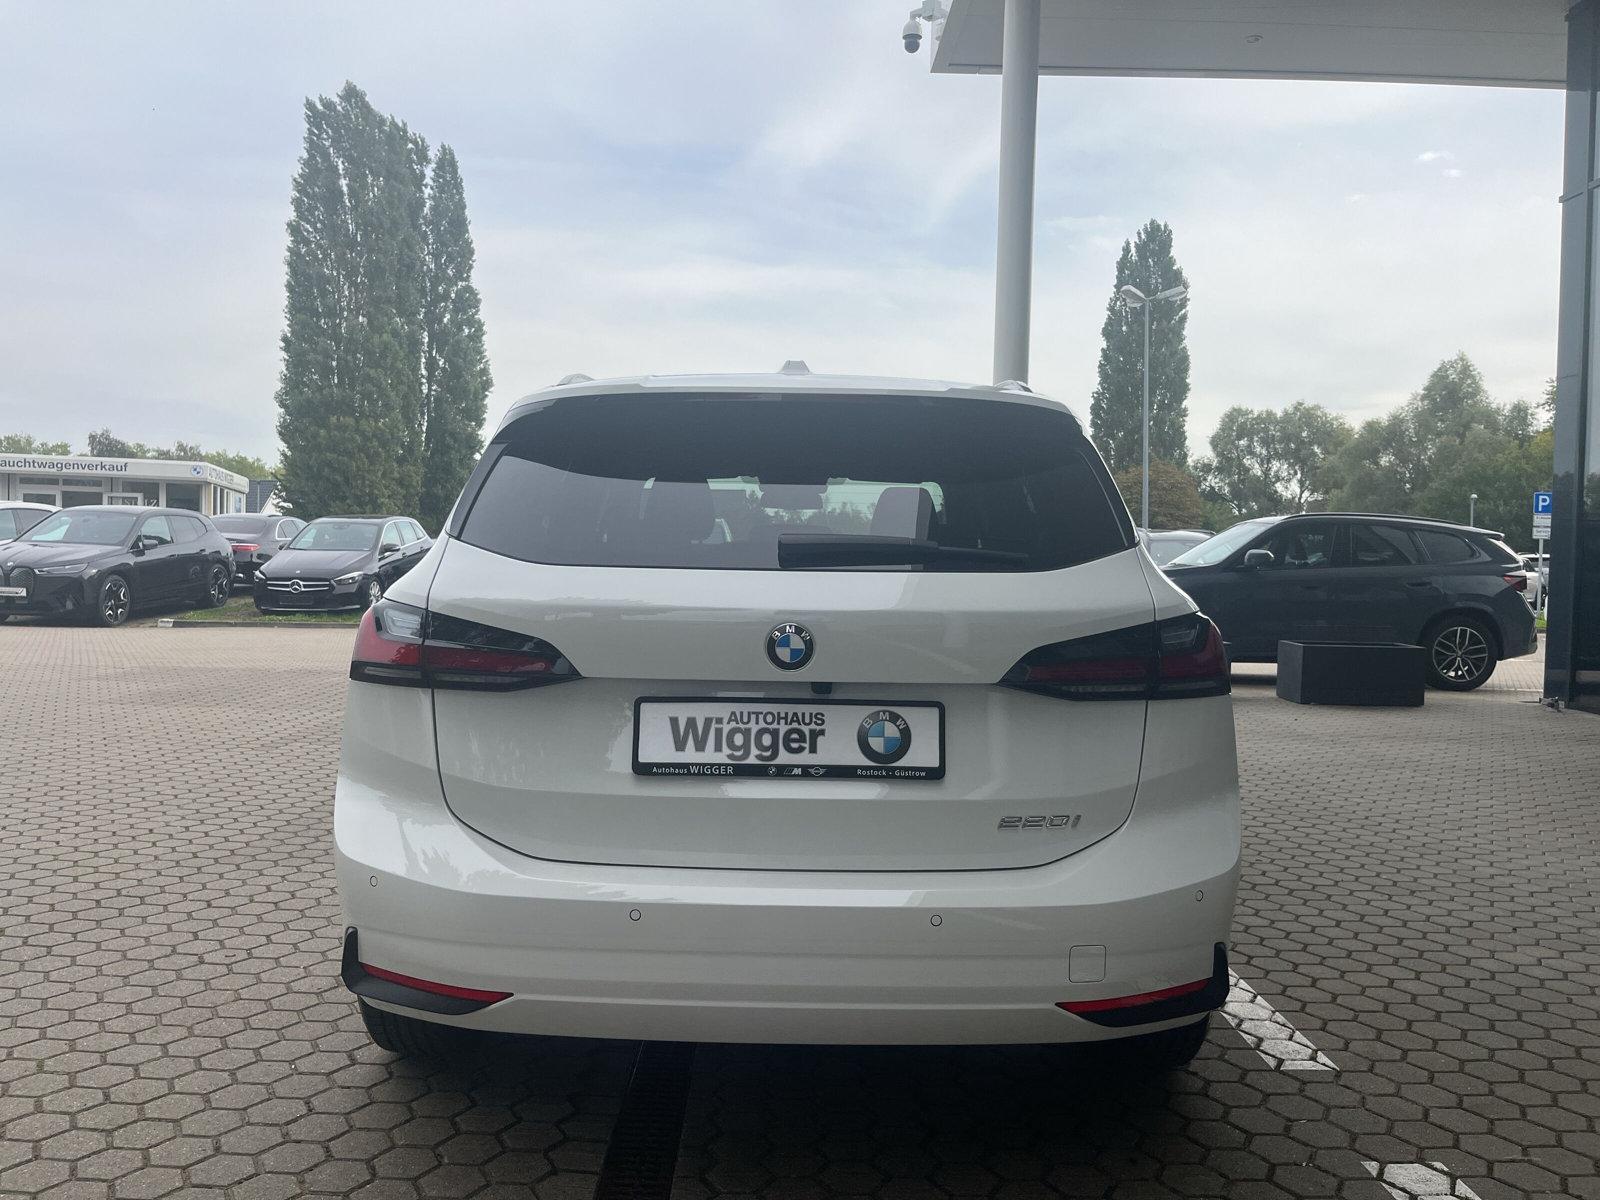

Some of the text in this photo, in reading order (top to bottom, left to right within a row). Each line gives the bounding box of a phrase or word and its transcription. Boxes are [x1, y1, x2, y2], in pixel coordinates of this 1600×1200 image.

[0, 458, 128, 472] auchtwagenverkauf
[1538, 495, 1550, 511] P
[772, 625, 810, 641] BMW
[726, 711, 825, 726] AUTOHAUS
[862, 711, 907, 729] BMW
[669, 716, 826, 762] Wigger
[652, 765, 734, 775] Autohaus WIGGER
[857, 768, 887, 777] Rostock
[998, 814, 1082, 829] 220i
